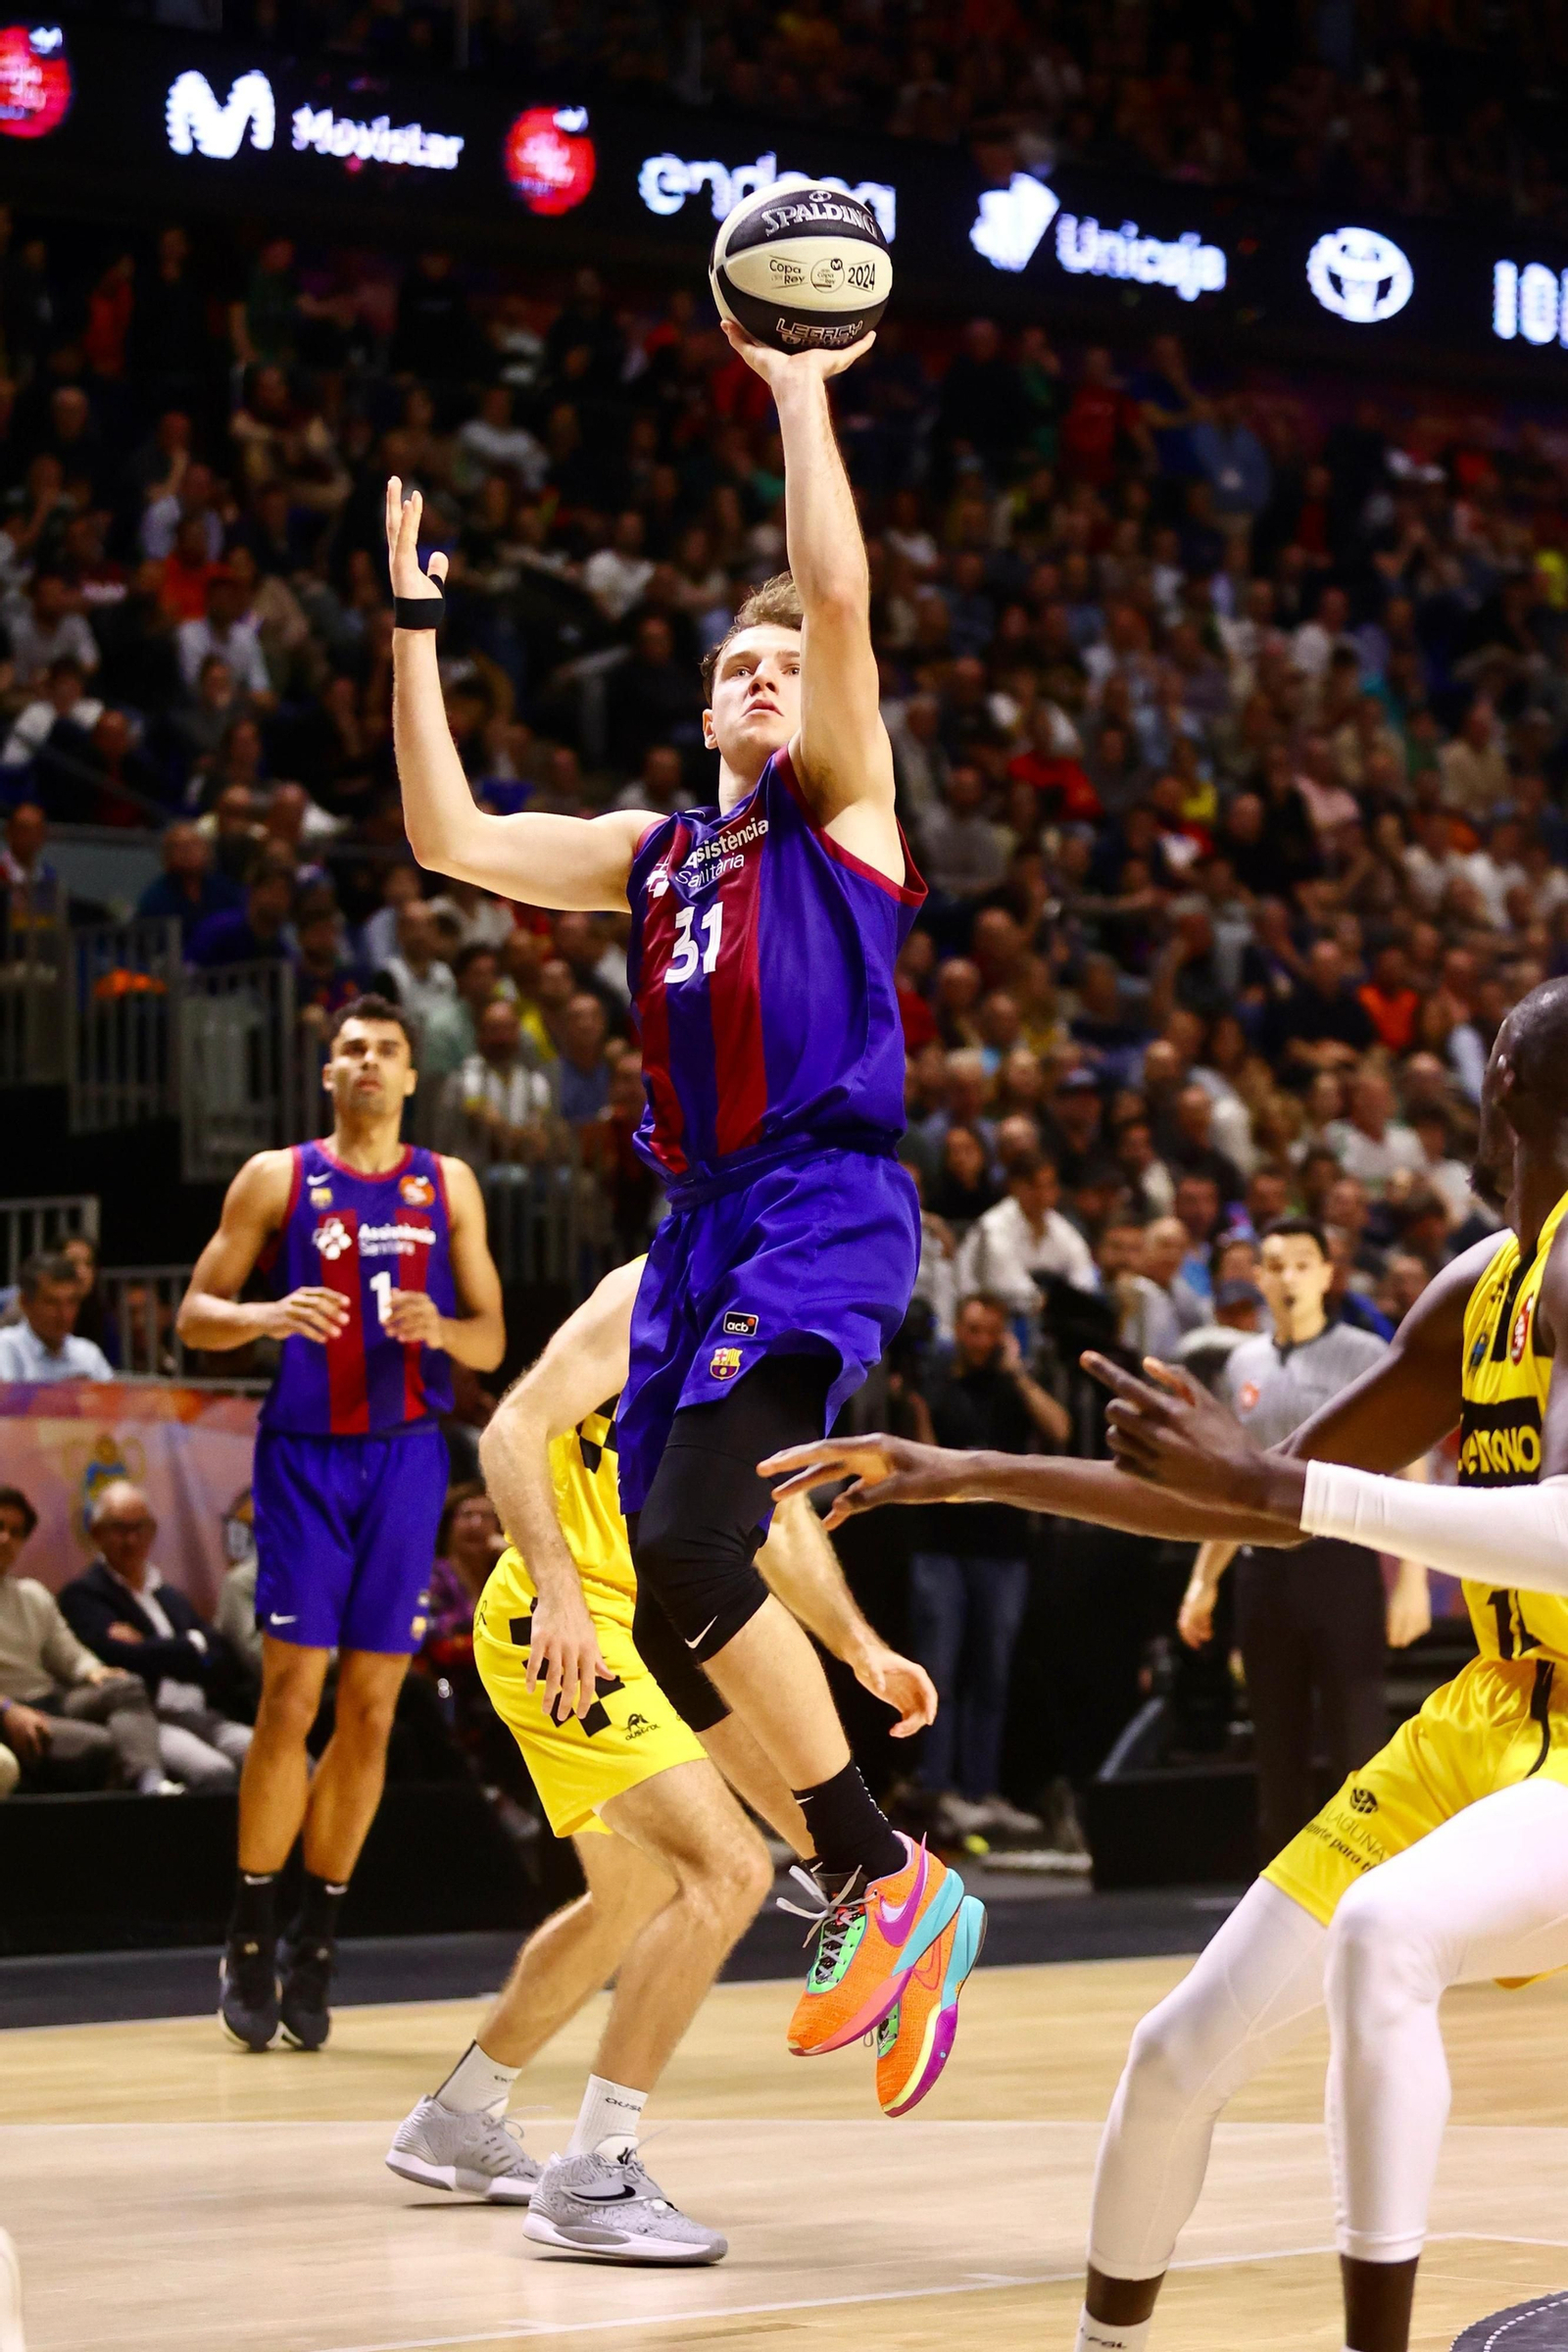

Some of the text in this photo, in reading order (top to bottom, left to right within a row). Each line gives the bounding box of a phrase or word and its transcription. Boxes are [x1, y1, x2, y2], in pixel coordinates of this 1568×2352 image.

[638, 150, 896, 244] enda
[761, 203, 877, 240] SPALDING
[769, 259, 802, 274] Copa
[784, 274, 805, 284] Rey
[848, 263, 875, 291] 2024
[776, 318, 862, 340] LEGACY
[681, 817, 769, 868] Asistència
[663, 901, 723, 984] 31
[369, 1271, 392, 1325] 1
[727, 1321, 749, 1333] acb
[1457, 1419, 1542, 1475] enovo
[1329, 1837, 1361, 1864] para
